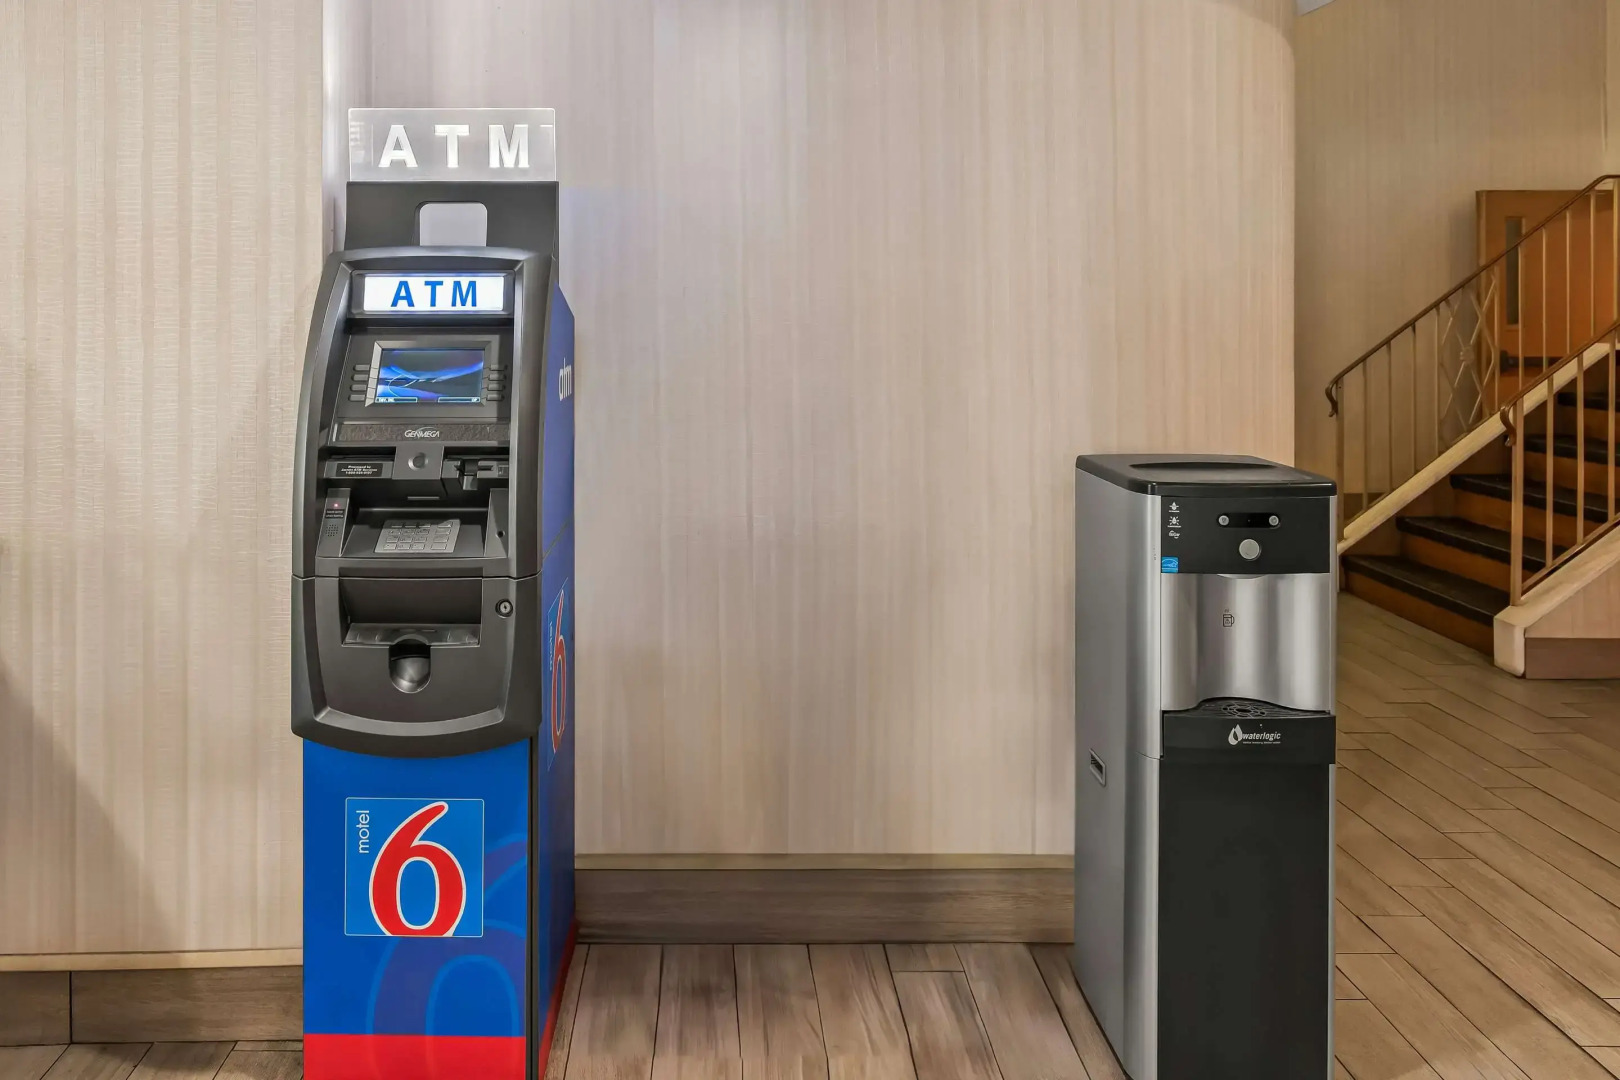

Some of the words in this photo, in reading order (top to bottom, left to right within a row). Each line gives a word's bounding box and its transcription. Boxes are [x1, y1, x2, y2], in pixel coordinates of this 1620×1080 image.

[378, 124, 530, 168] ATM
[390, 280, 478, 308] ATM
[558, 356, 572, 402] atm
[404, 429, 440, 438] GENMEGA
[1241, 731, 1281, 742] waterlogic
[355, 809, 370, 854] motel
[368, 800, 467, 937] 6
